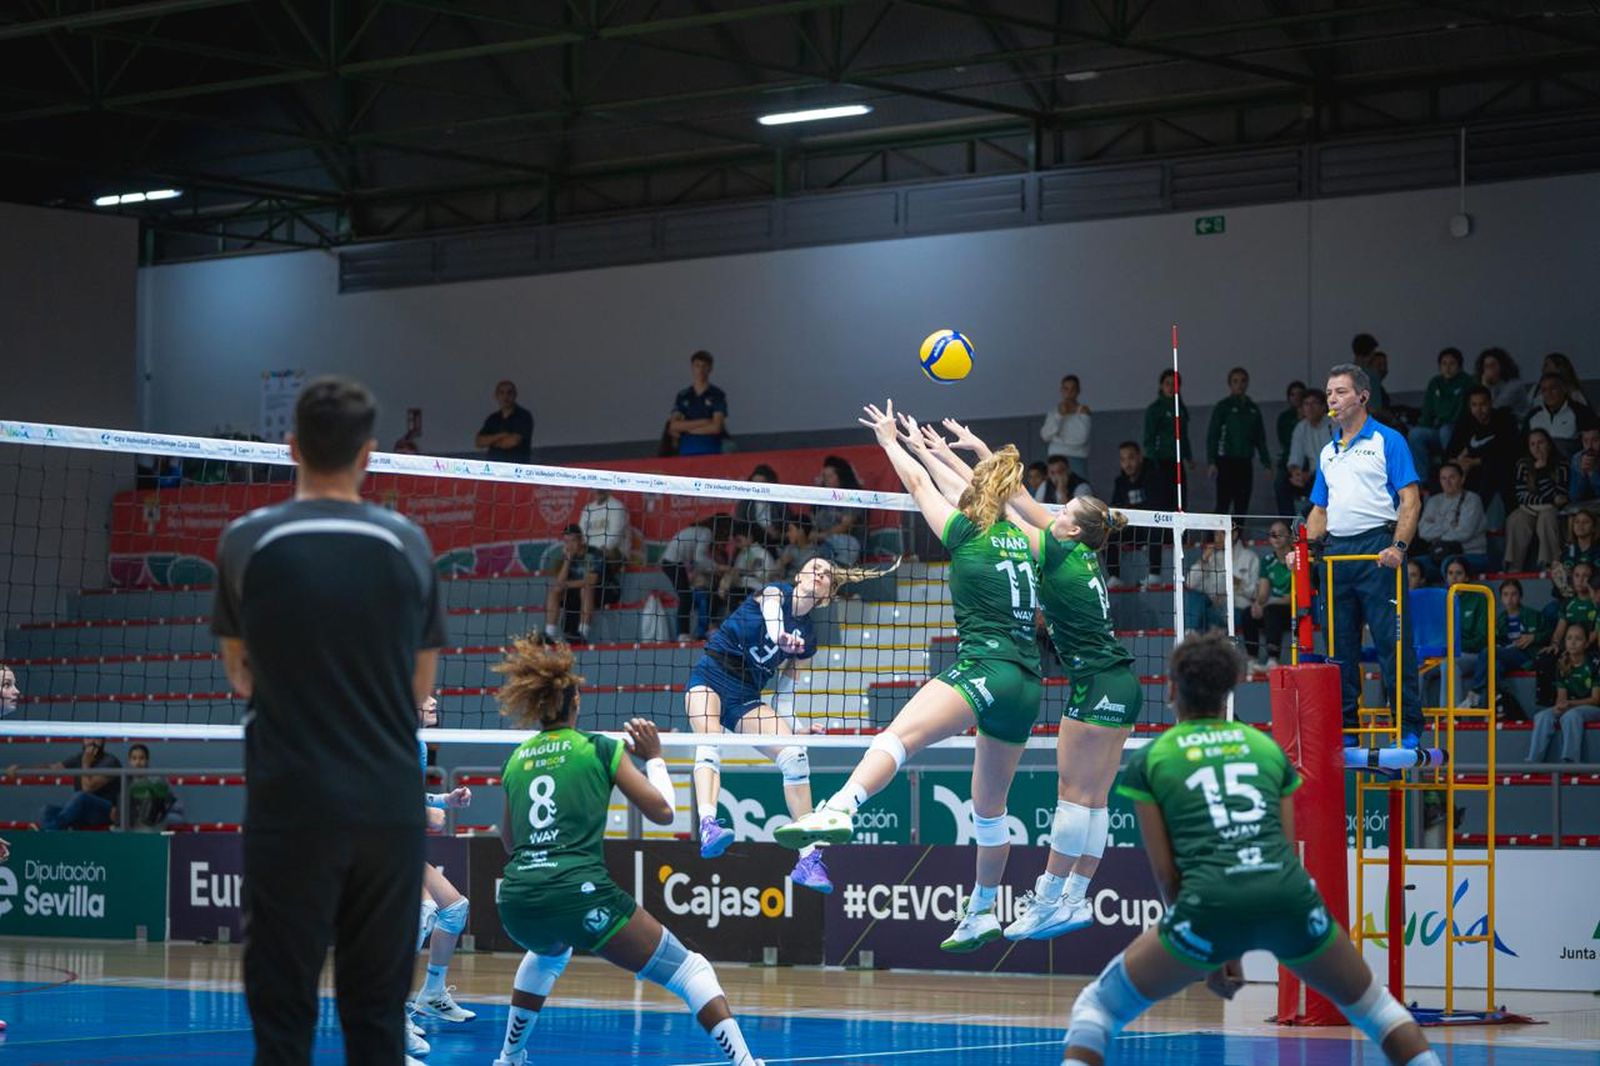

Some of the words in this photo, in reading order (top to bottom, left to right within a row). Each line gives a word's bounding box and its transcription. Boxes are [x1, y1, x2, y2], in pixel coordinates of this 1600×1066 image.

[990, 535, 1028, 550] EVANS
[995, 560, 1035, 608] 11
[1013, 610, 1034, 621] WAY
[1177, 729, 1246, 748] LOUISE
[517, 742, 561, 760] MAGUI
[528, 774, 558, 830] 8
[1184, 761, 1268, 829] 15
[529, 828, 560, 844] WAY
[1219, 823, 1262, 840] WAY
[24, 859, 107, 885] Diputación
[190, 860, 243, 908] Eur
[23, 884, 106, 918] Sevilla
[662, 872, 794, 929] Cajasol
[1559, 946, 1597, 961] Junta
